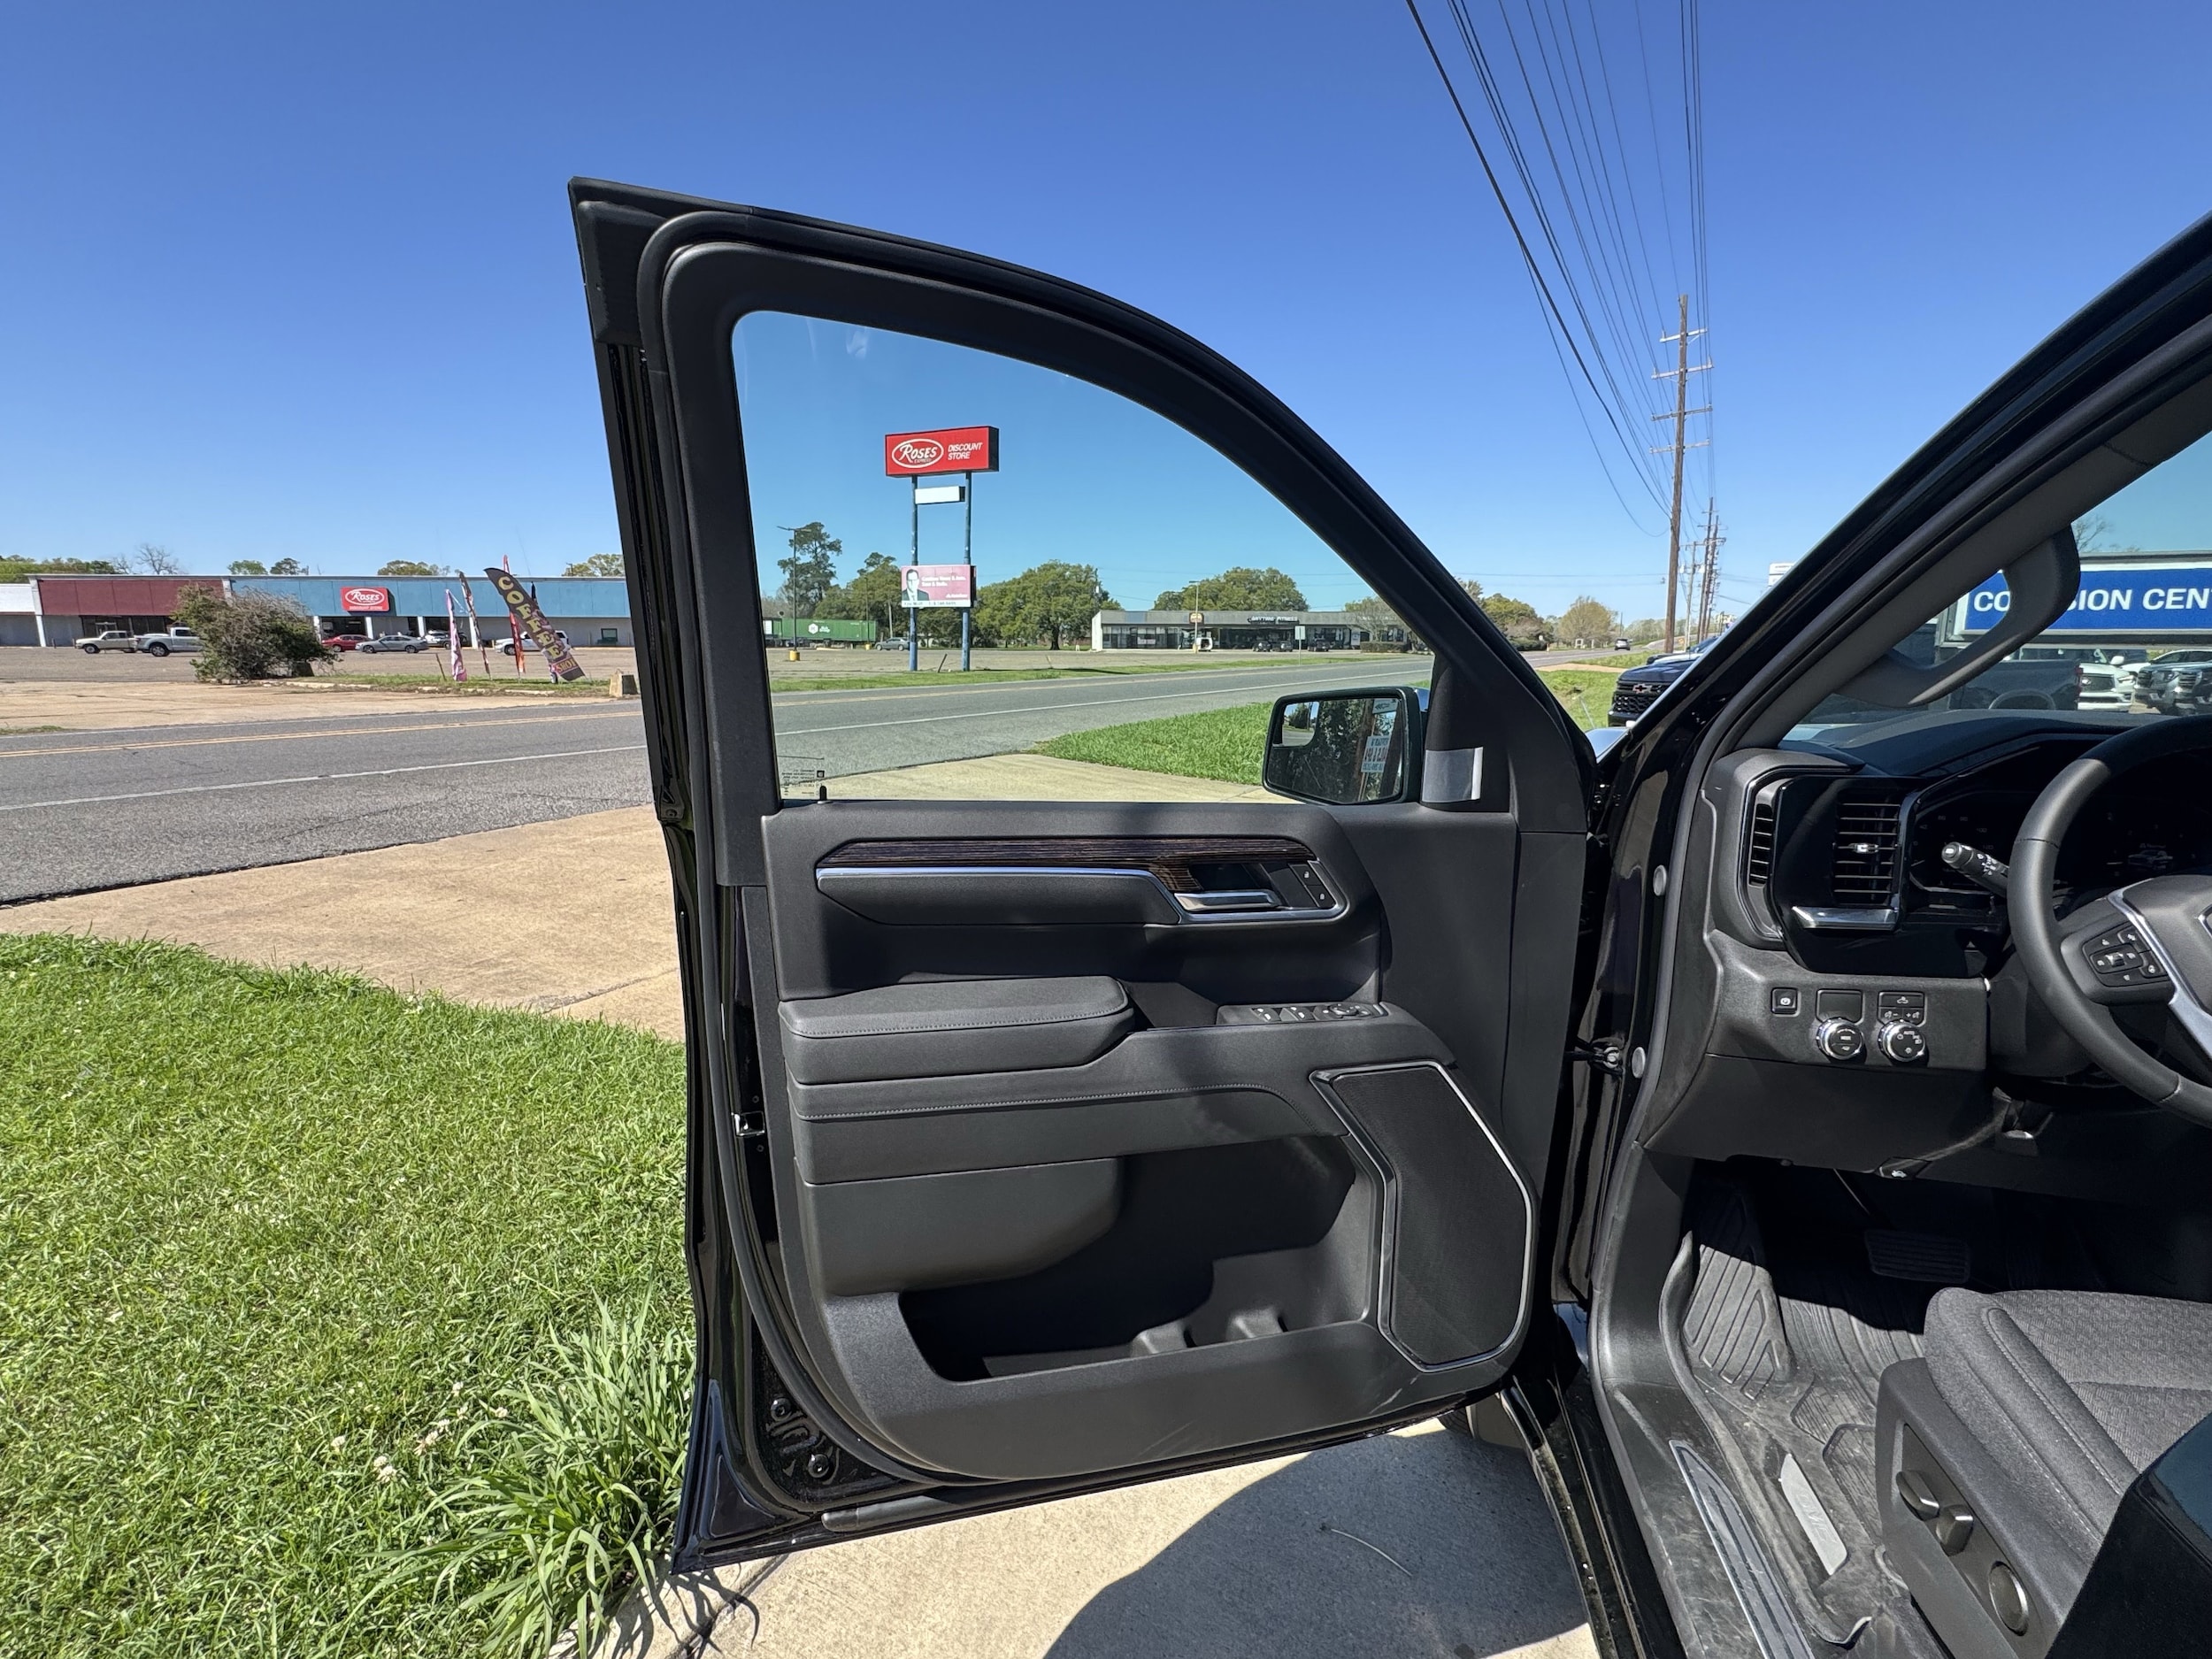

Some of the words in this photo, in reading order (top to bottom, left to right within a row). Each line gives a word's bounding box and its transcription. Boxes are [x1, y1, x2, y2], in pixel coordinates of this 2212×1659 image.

[898, 443, 938, 464] ROSES
[947, 442, 983, 452] DISCOUNT
[947, 451, 971, 461] STORE
[1974, 589, 2132, 611] COION
[2142, 588, 2212, 611] CEN
[498, 576, 564, 660] COFFEE
